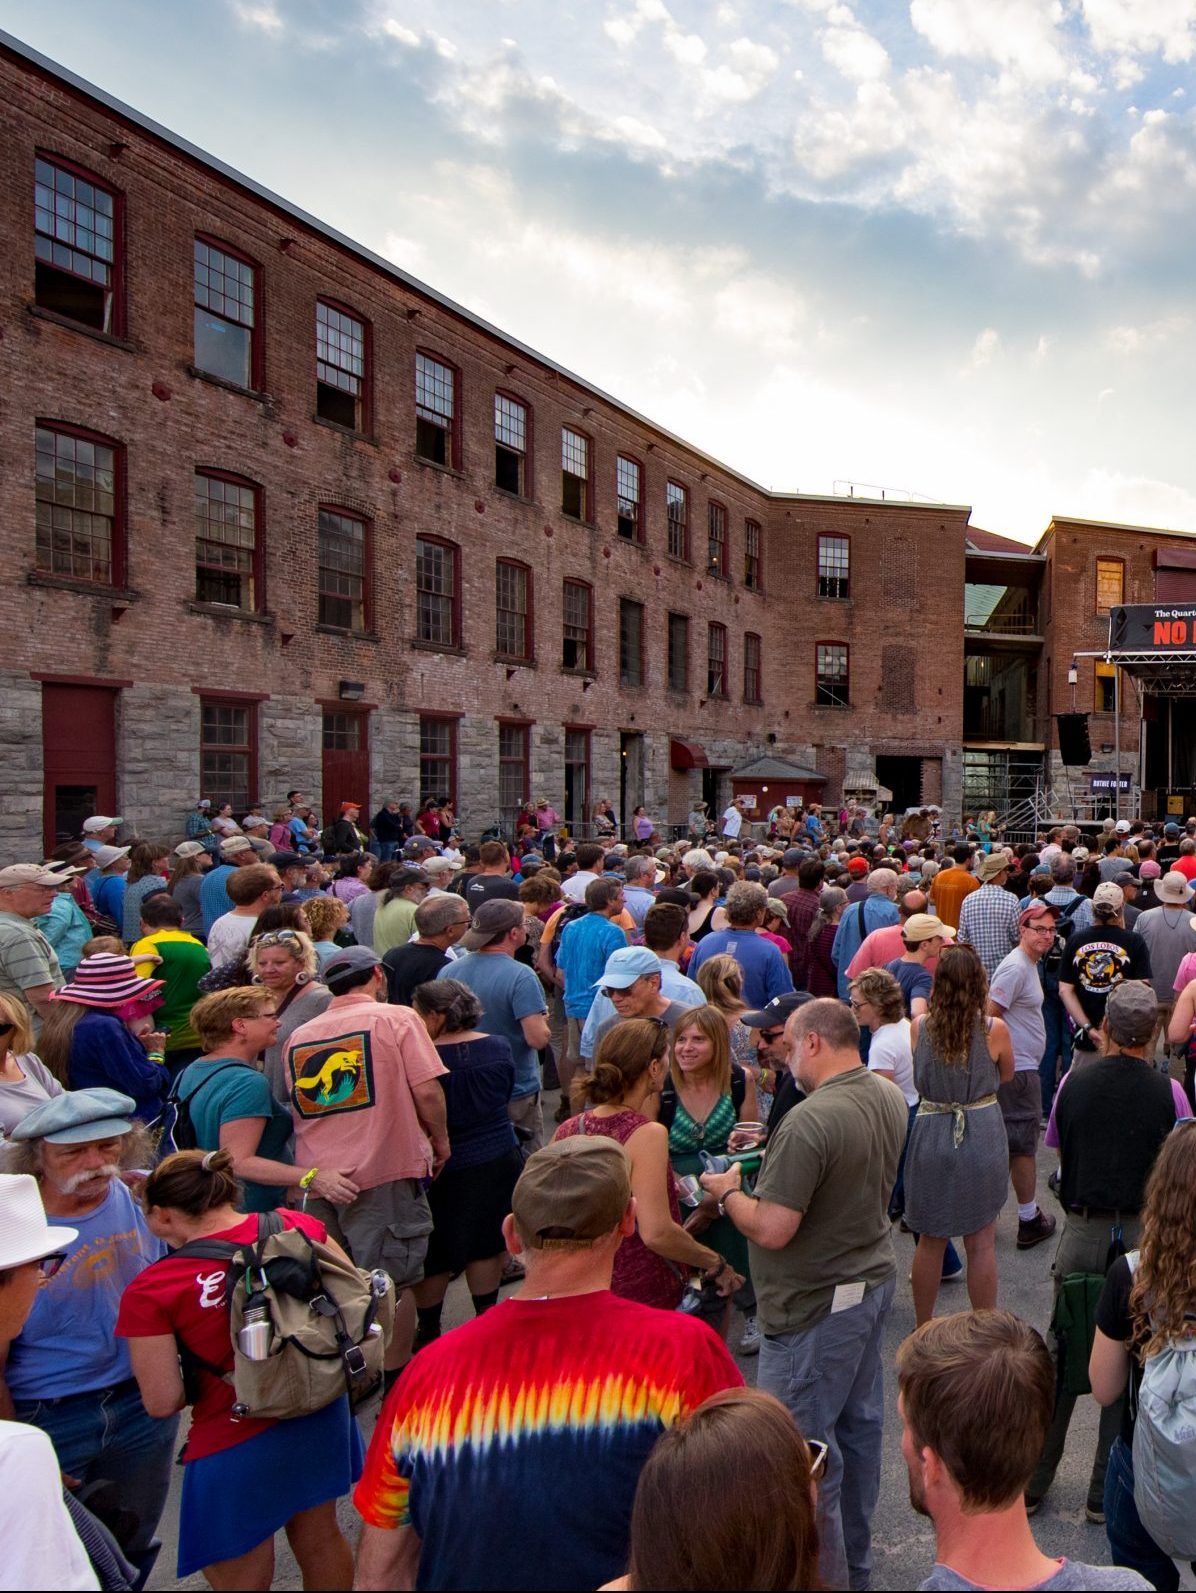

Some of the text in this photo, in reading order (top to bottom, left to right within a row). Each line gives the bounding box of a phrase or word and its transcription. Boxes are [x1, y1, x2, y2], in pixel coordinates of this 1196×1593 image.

[1154, 609, 1171, 618] The
[1153, 620, 1187, 645] NO
[1110, 780, 1128, 788] FOTER
